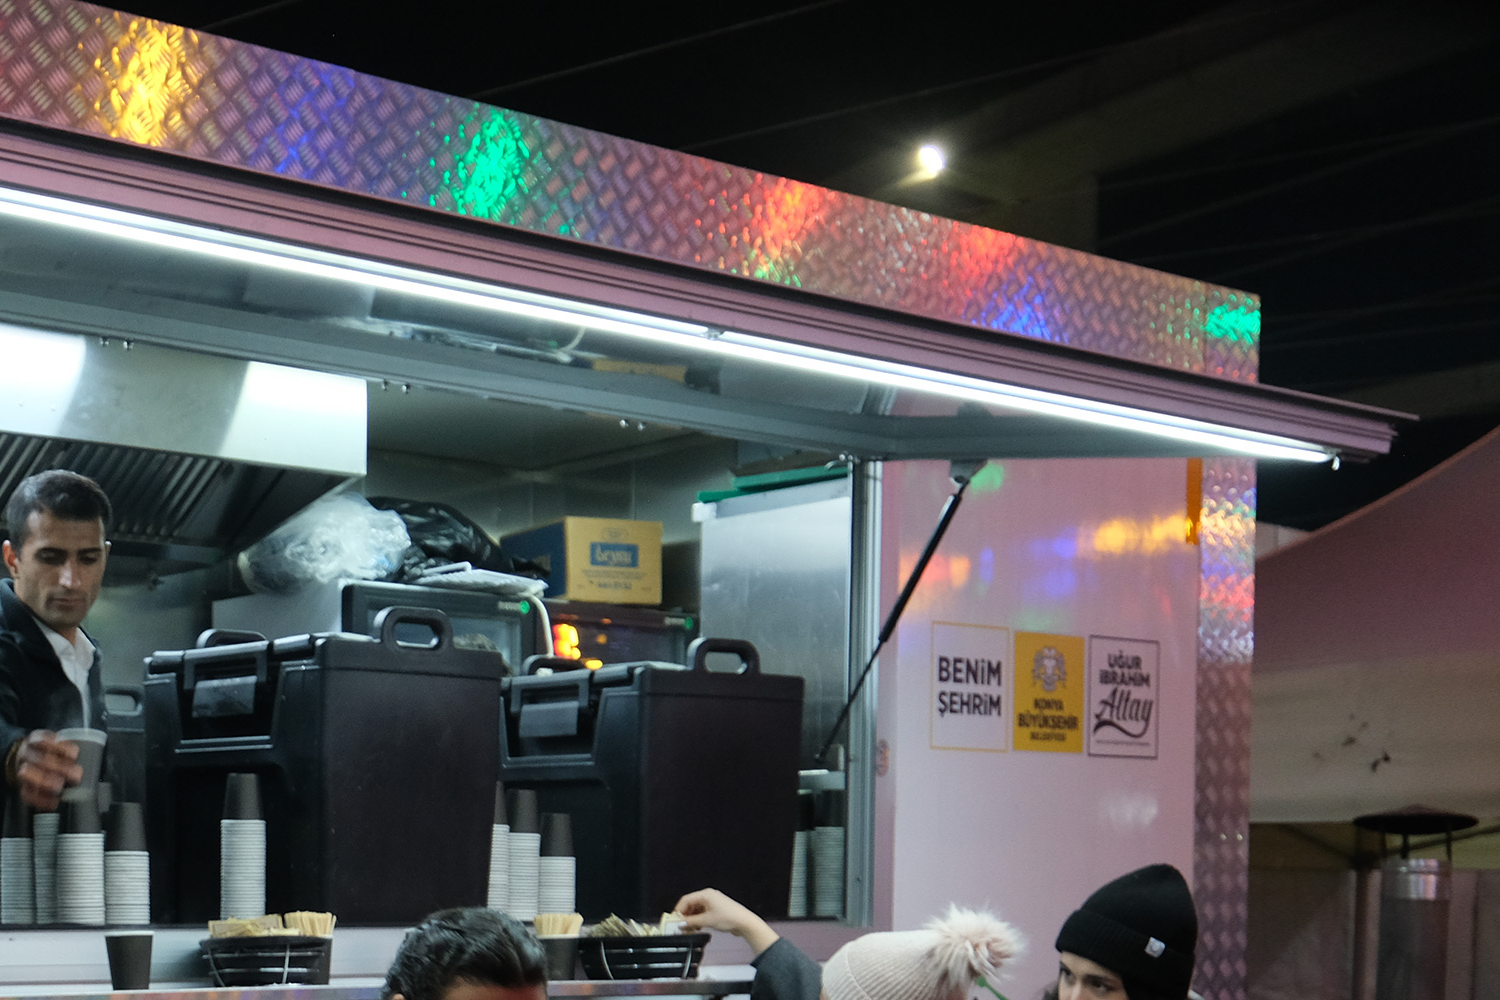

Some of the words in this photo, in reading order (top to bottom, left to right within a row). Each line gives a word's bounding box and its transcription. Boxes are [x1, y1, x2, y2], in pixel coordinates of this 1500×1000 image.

[938, 656, 1003, 686] BENİM
[938, 691, 1003, 718] ŞEHRİM
[1093, 687, 1153, 738] Altay
